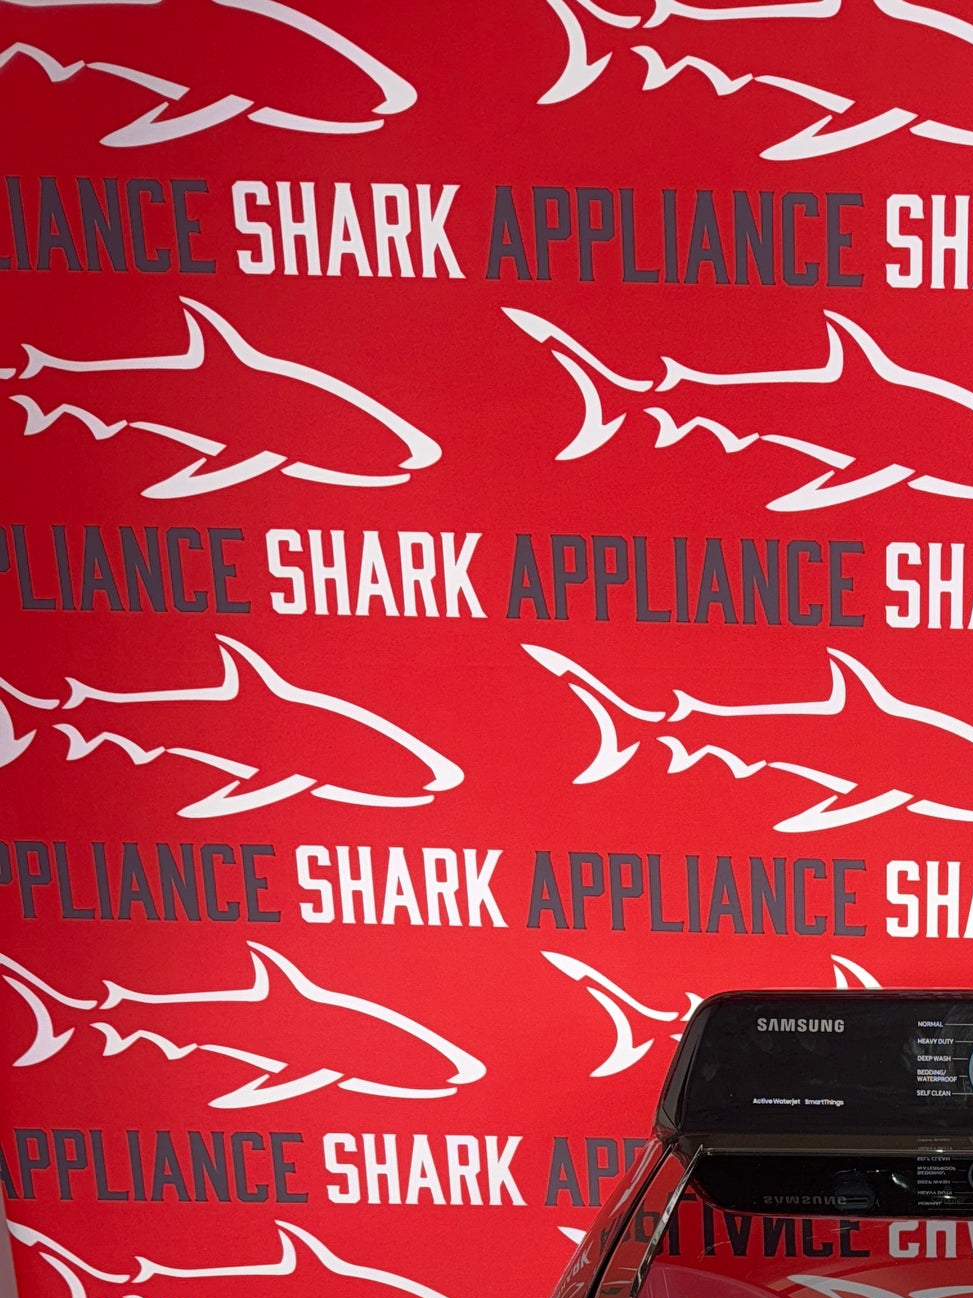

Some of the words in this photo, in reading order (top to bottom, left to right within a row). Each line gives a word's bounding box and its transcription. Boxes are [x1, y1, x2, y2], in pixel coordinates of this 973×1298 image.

[0, 176, 216, 273] IANCE
[231, 180, 467, 279] SHARK
[486, 186, 864, 287] APPLIANCE
[0, 524, 250, 613] LIANCE
[265, 529, 488, 618] SHARK
[507, 534, 864, 627] APPLIANCE
[295, 845, 509, 928] SHARK
[527, 851, 867, 937] APPLIANCE
[757, 1017, 845, 1033] SAMSUNG
[804, 1098, 844, 1107] SmartThings
[323, 1133, 528, 1206] SHARK
